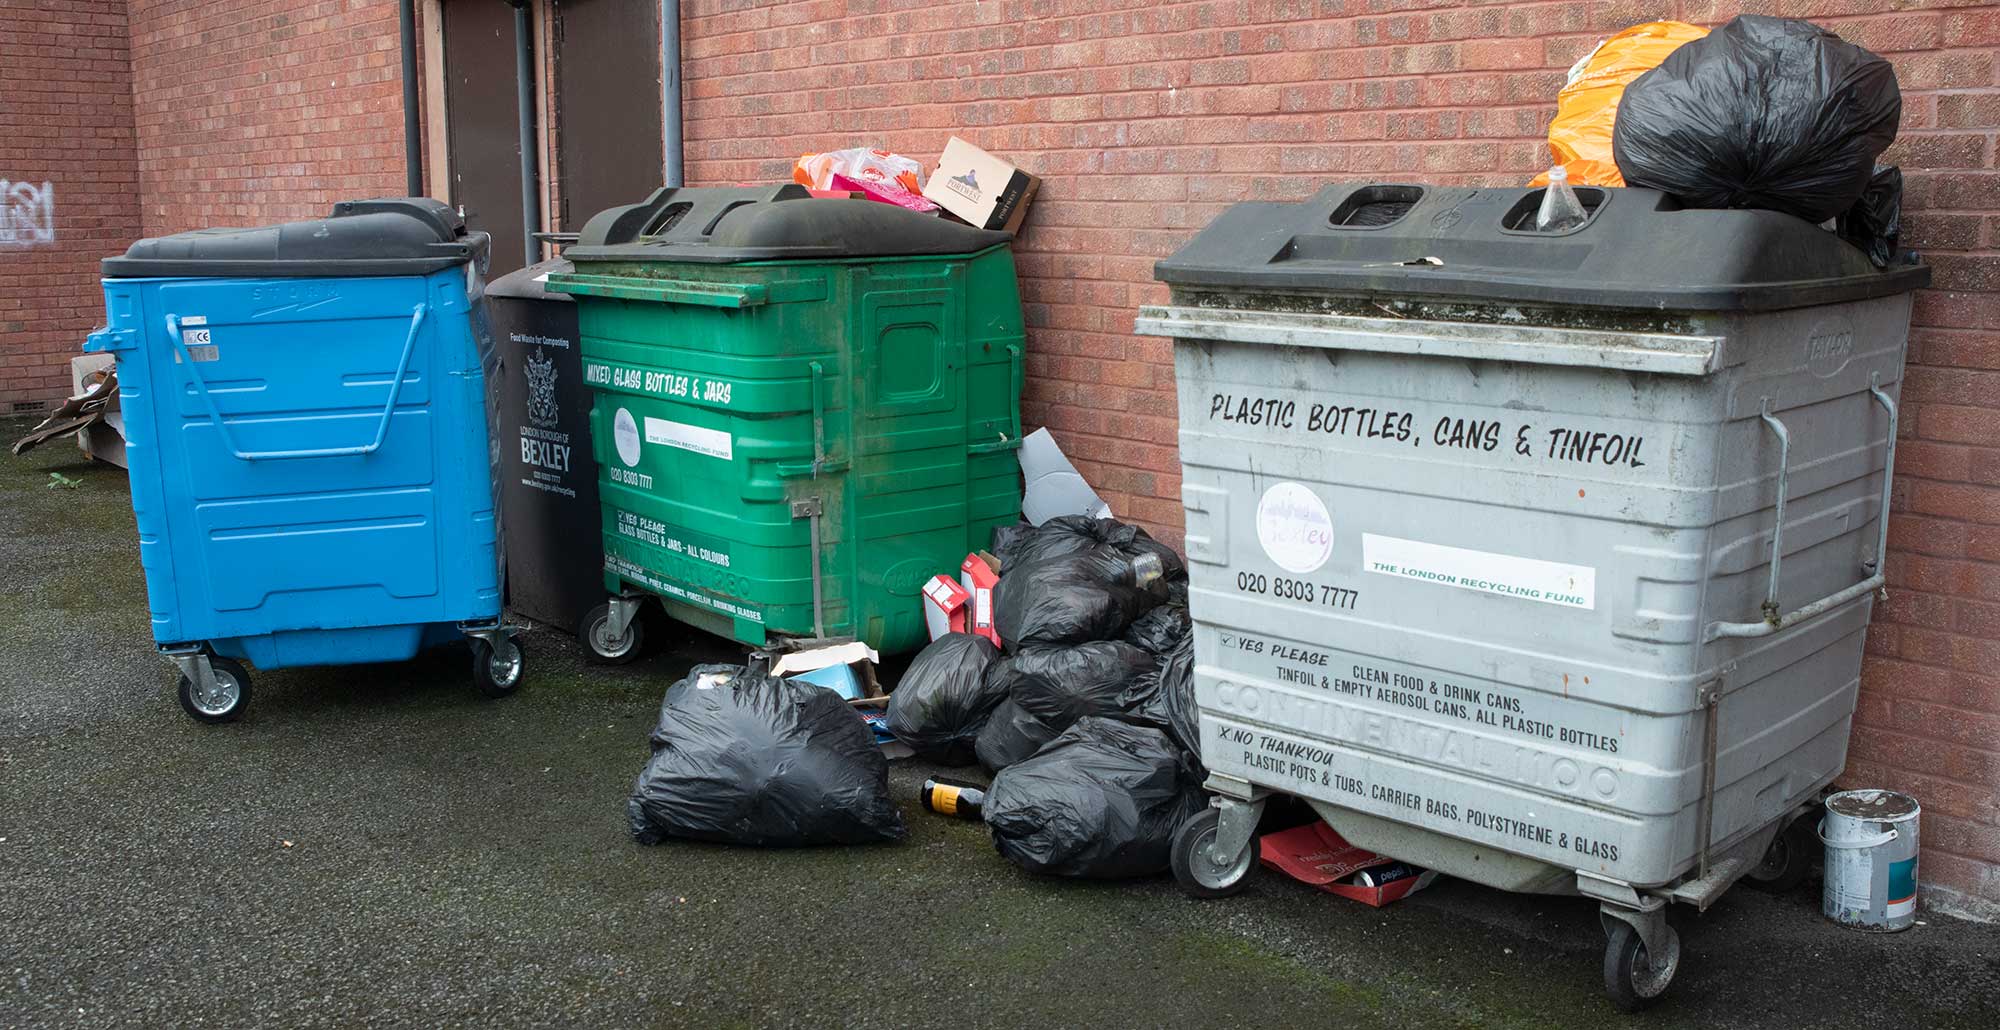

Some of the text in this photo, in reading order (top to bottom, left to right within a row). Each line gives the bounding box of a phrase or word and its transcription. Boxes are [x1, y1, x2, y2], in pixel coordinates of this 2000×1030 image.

[587, 364, 732, 404] MIXED GLASS BOTTLES & JARS
[520, 425, 540, 438] LONDON
[649, 435, 729, 458] THE LONDON RECYCLING FUND
[1210, 394, 1646, 468] PLASTIC BOTTLES, CANS & TINFOIL
[521, 437, 571, 472] BEXLEY
[610, 467, 653, 490] 020 8303 7777
[625, 512, 666, 535] YES PLEASE
[618, 522, 636, 537] GLASS
[636, 527, 660, 545] BOTTLES
[660, 535, 666, 547] &
[667, 537, 683, 553] JARS
[687, 544, 699, 558] ALL
[700, 547, 730, 567] COLOURS
[1237, 571, 1359, 610] 020 8303 7777
[1373, 562, 1586, 606] THE LONDON RECYCLING FUND
[737, 606, 762, 620] GLASSES
[1239, 637, 1330, 667] YES PLEASE
[1352, 665, 1389, 685] CLEAN
[1393, 673, 1424, 692] FOOD
[1429, 680, 1439, 696] &
[1444, 683, 1481, 705] DRINK
[1276, 666, 1317, 688] TINFOIL
[1321, 675, 1330, 690] &
[1334, 678, 1374, 699] EMPTY
[1376, 688, 1429, 712] AEROSOL
[1475, 708, 1498, 727] ALL
[1503, 714, 1554, 739] PLASTIC
[1560, 727, 1618, 753] BOTTLES
[1232, 730, 1335, 766] NO THANKYOU
[1243, 751, 1286, 775] PLASTIC
[1290, 763, 1317, 783] POTS
[1321, 770, 1330, 786] &
[1371, 784, 1422, 811] CARRIER
[1466, 808, 1553, 845] POLYSTYRENE
[1558, 832, 1569, 849] &
[1575, 835, 1619, 862] GLASS
[1380, 866, 1405, 883] pepsi
